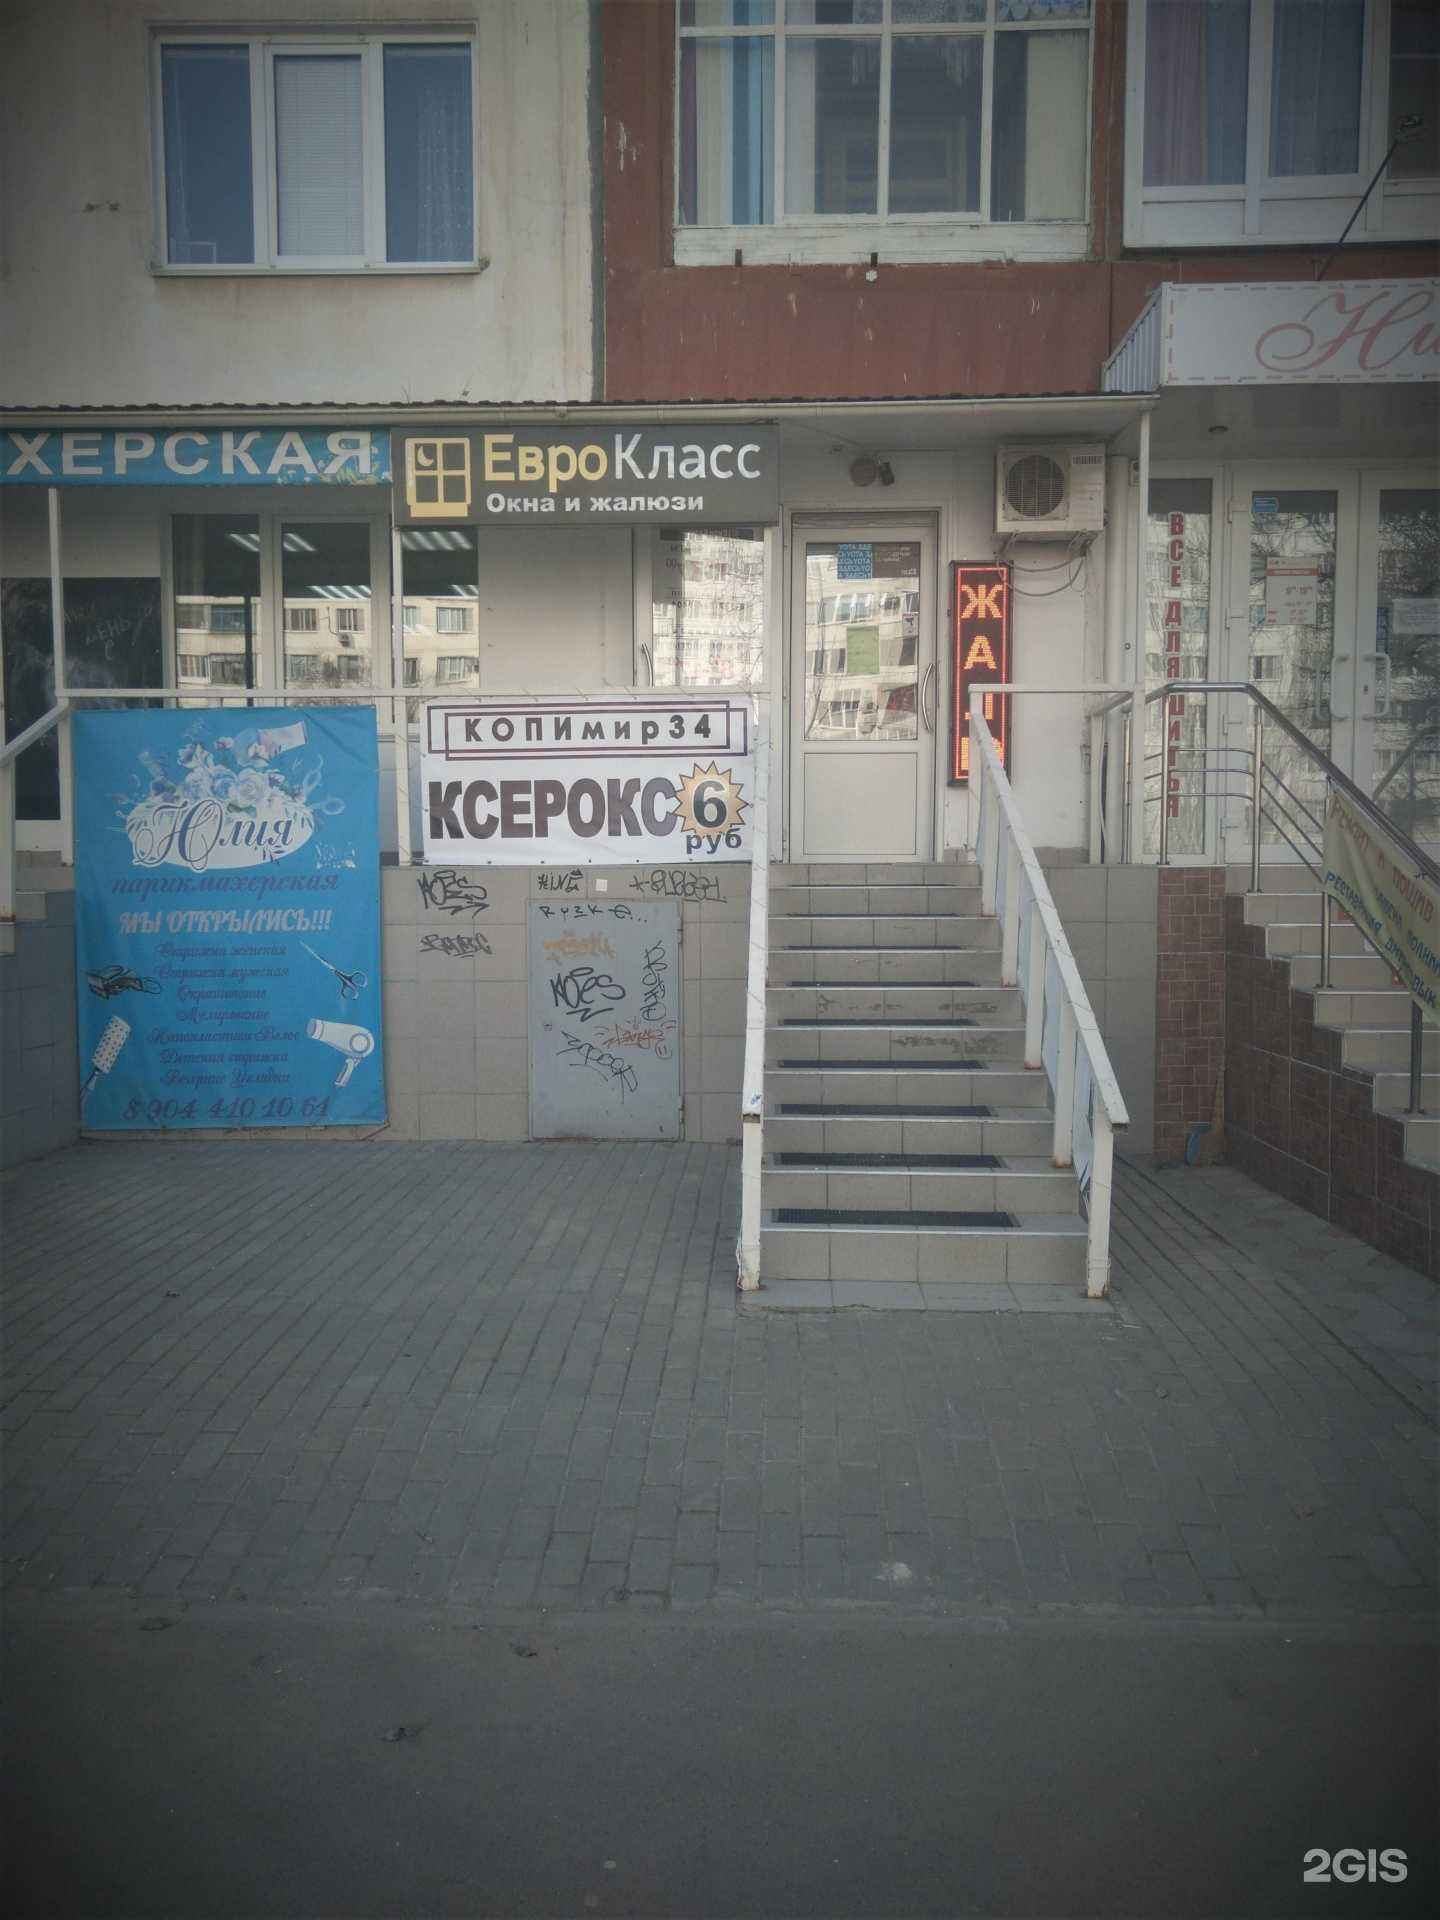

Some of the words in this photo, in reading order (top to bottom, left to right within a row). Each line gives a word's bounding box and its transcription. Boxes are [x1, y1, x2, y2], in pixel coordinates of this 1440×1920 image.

[485, 492, 555, 513] Окна
[565, 494, 581, 512] и
[589, 493, 704, 513] жалюзи
[1169, 513, 1184, 588] ВСЕ
[1165, 601, 1182, 679] ДЛЯ
[464, 714, 712, 745] КОПИмир34
[428, 777, 679, 840] КСЕРОКС
[693, 780, 728, 828] 6
[133, 799, 294, 871] Юлия
[686, 824, 743, 854] руб
[112, 873, 339, 902] парикмахерская
[1392, 864, 1435, 924] ПОШИВ
[119, 911, 161, 935] МЫ
[167, 908, 332, 934] ОТКРЫЛИСЬ!!!
[123, 1098, 139, 1121] 8
[209, 1097, 256, 1120] 410
[262, 1096, 294, 1120] 10
